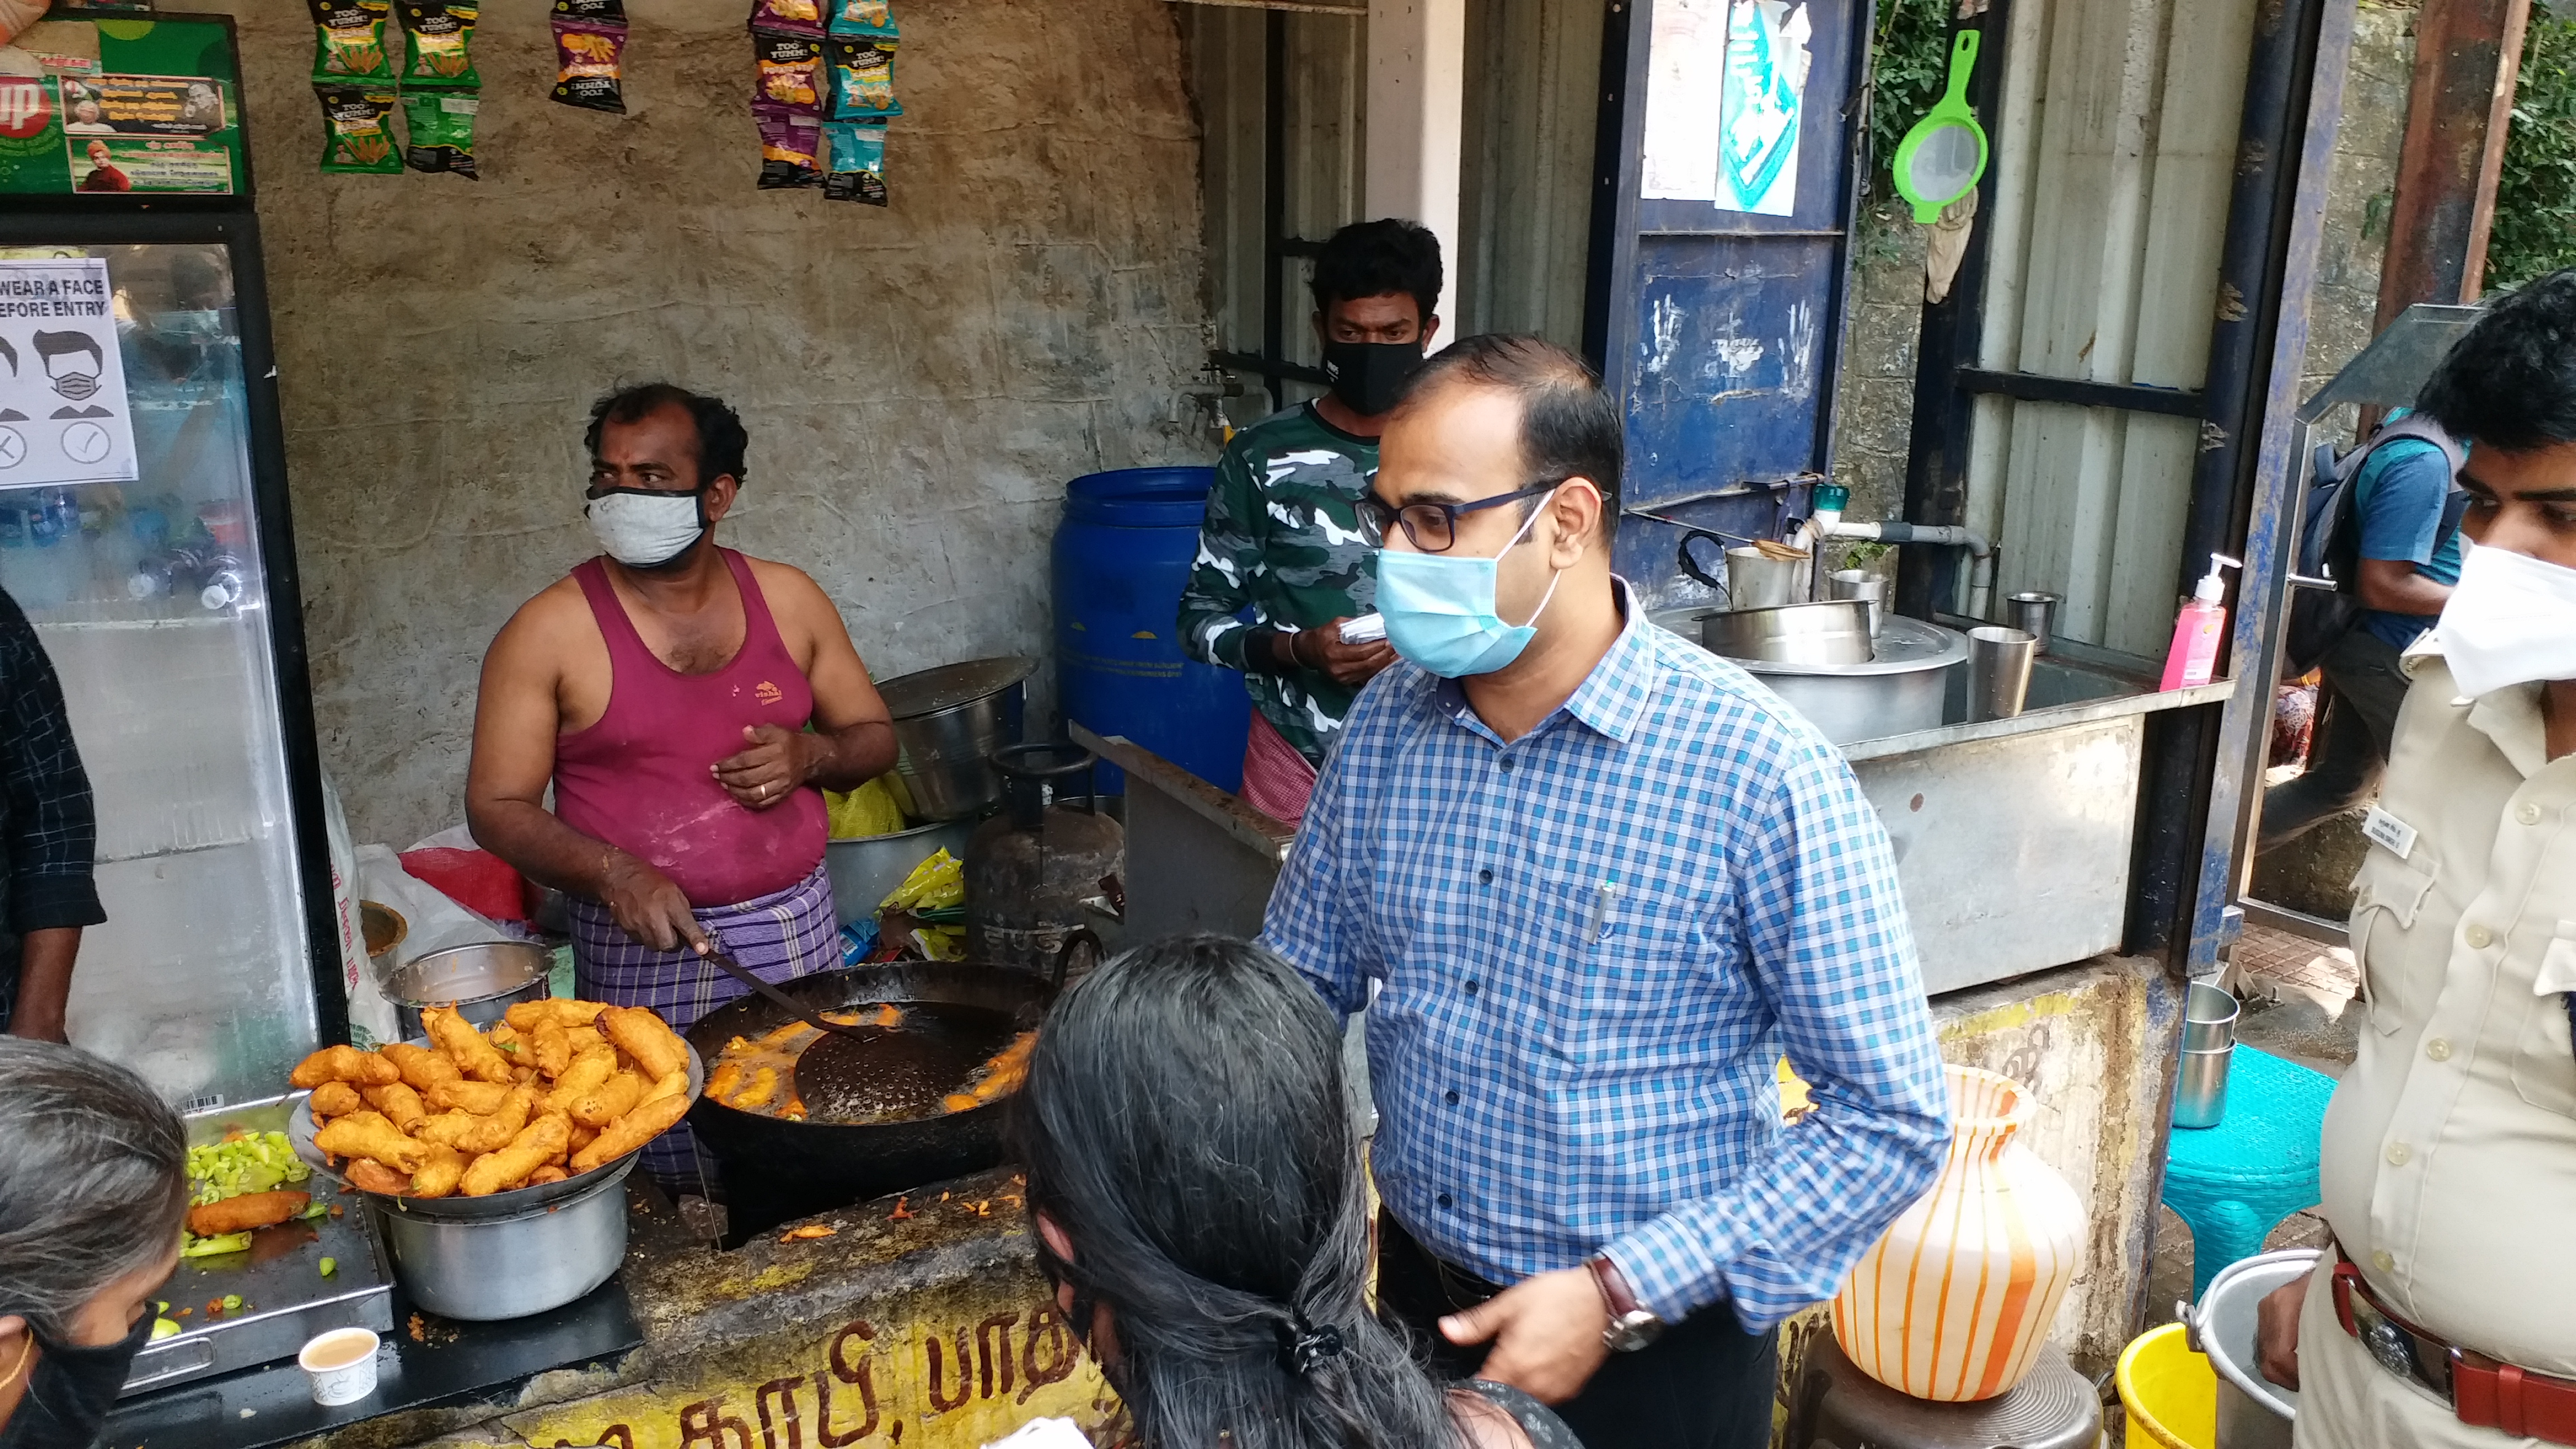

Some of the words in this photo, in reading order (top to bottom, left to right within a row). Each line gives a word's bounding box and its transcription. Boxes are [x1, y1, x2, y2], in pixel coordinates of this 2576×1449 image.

[770, 49, 808, 59] YUMM!
[856, 50, 877, 59] TOO
[49, 280, 60, 296] A
[62, 280, 104, 295] FACE
[53, 301, 105, 316] ENTRY
